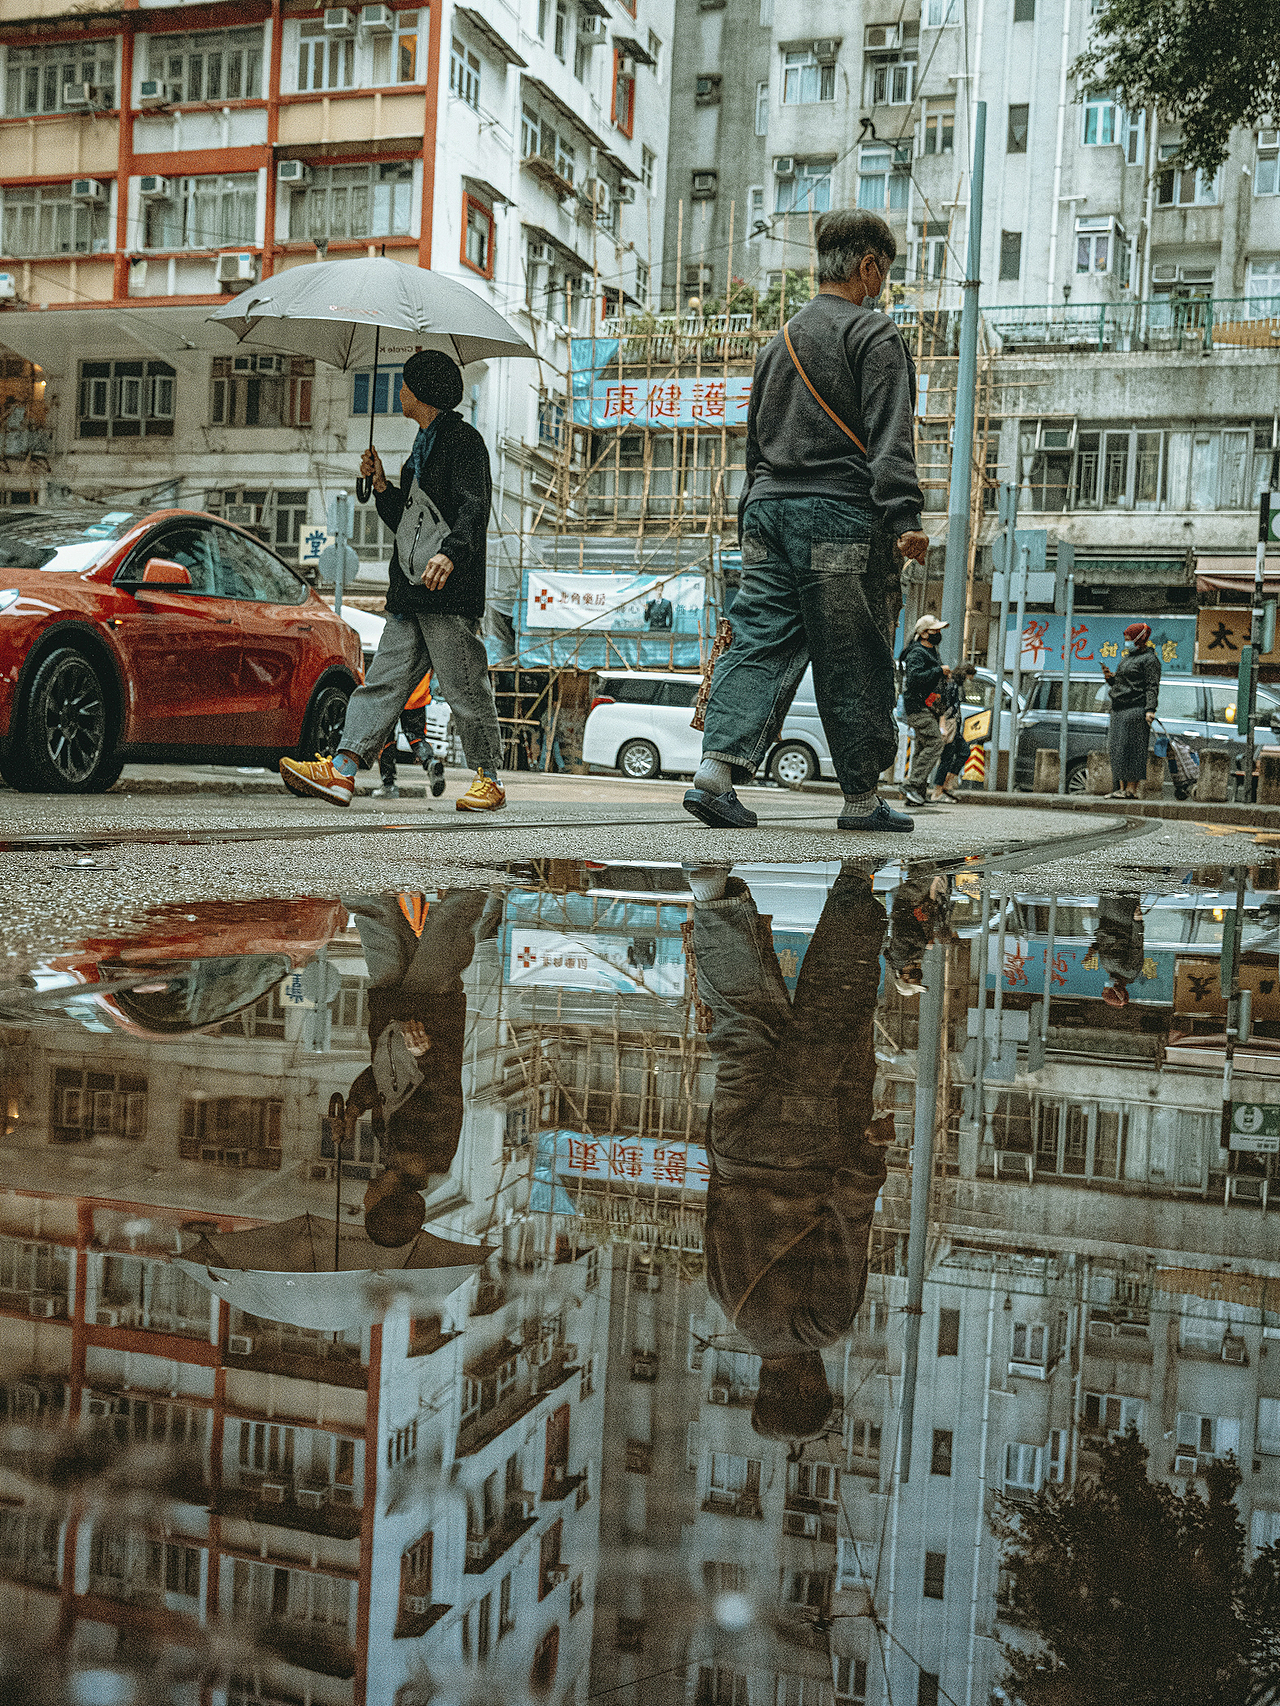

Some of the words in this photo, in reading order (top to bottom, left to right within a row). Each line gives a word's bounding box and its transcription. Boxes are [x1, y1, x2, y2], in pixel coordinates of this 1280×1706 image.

[604, 382, 753, 418] 康健護
[304, 530, 327, 560] 堂
